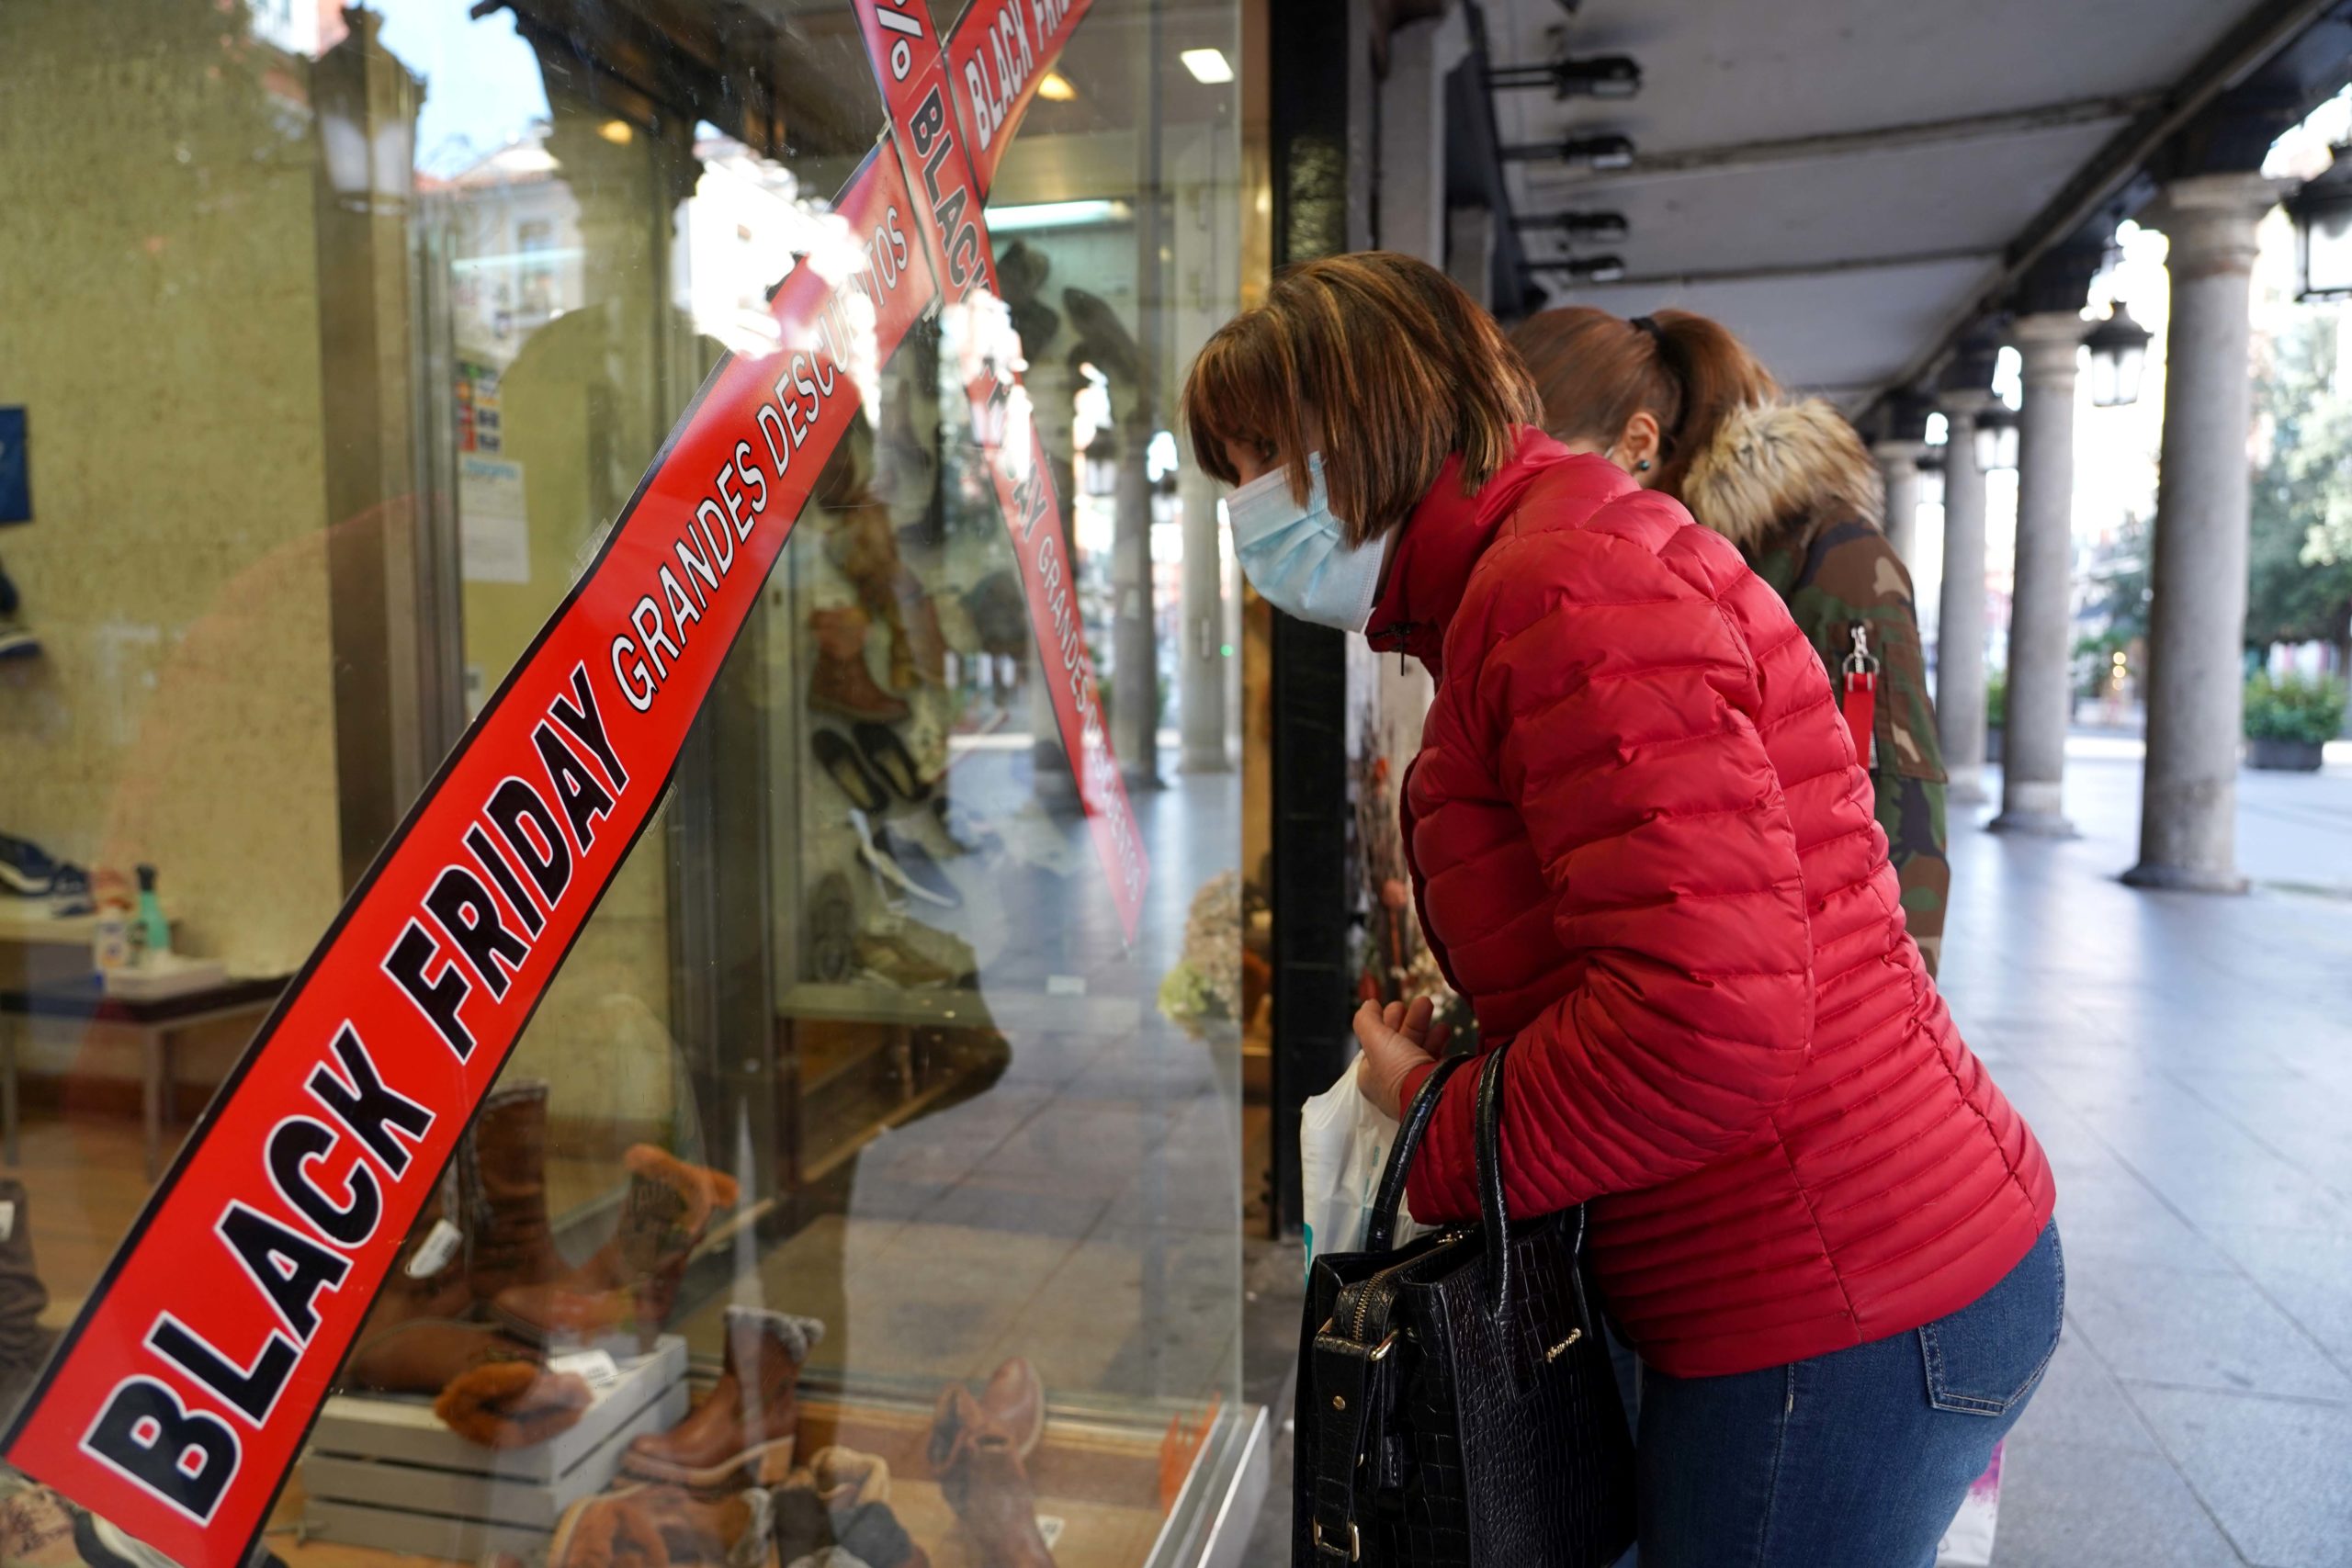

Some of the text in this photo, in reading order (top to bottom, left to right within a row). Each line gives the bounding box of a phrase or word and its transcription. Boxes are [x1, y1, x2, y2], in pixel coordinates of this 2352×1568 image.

[964, 0, 1035, 152] BLACK
[1038, 536, 1089, 713] GRANDES
[78, 1018, 437, 1529] BLACK
[379, 659, 630, 1066] FRIDAY
[609, 439, 769, 715] GRANDES
